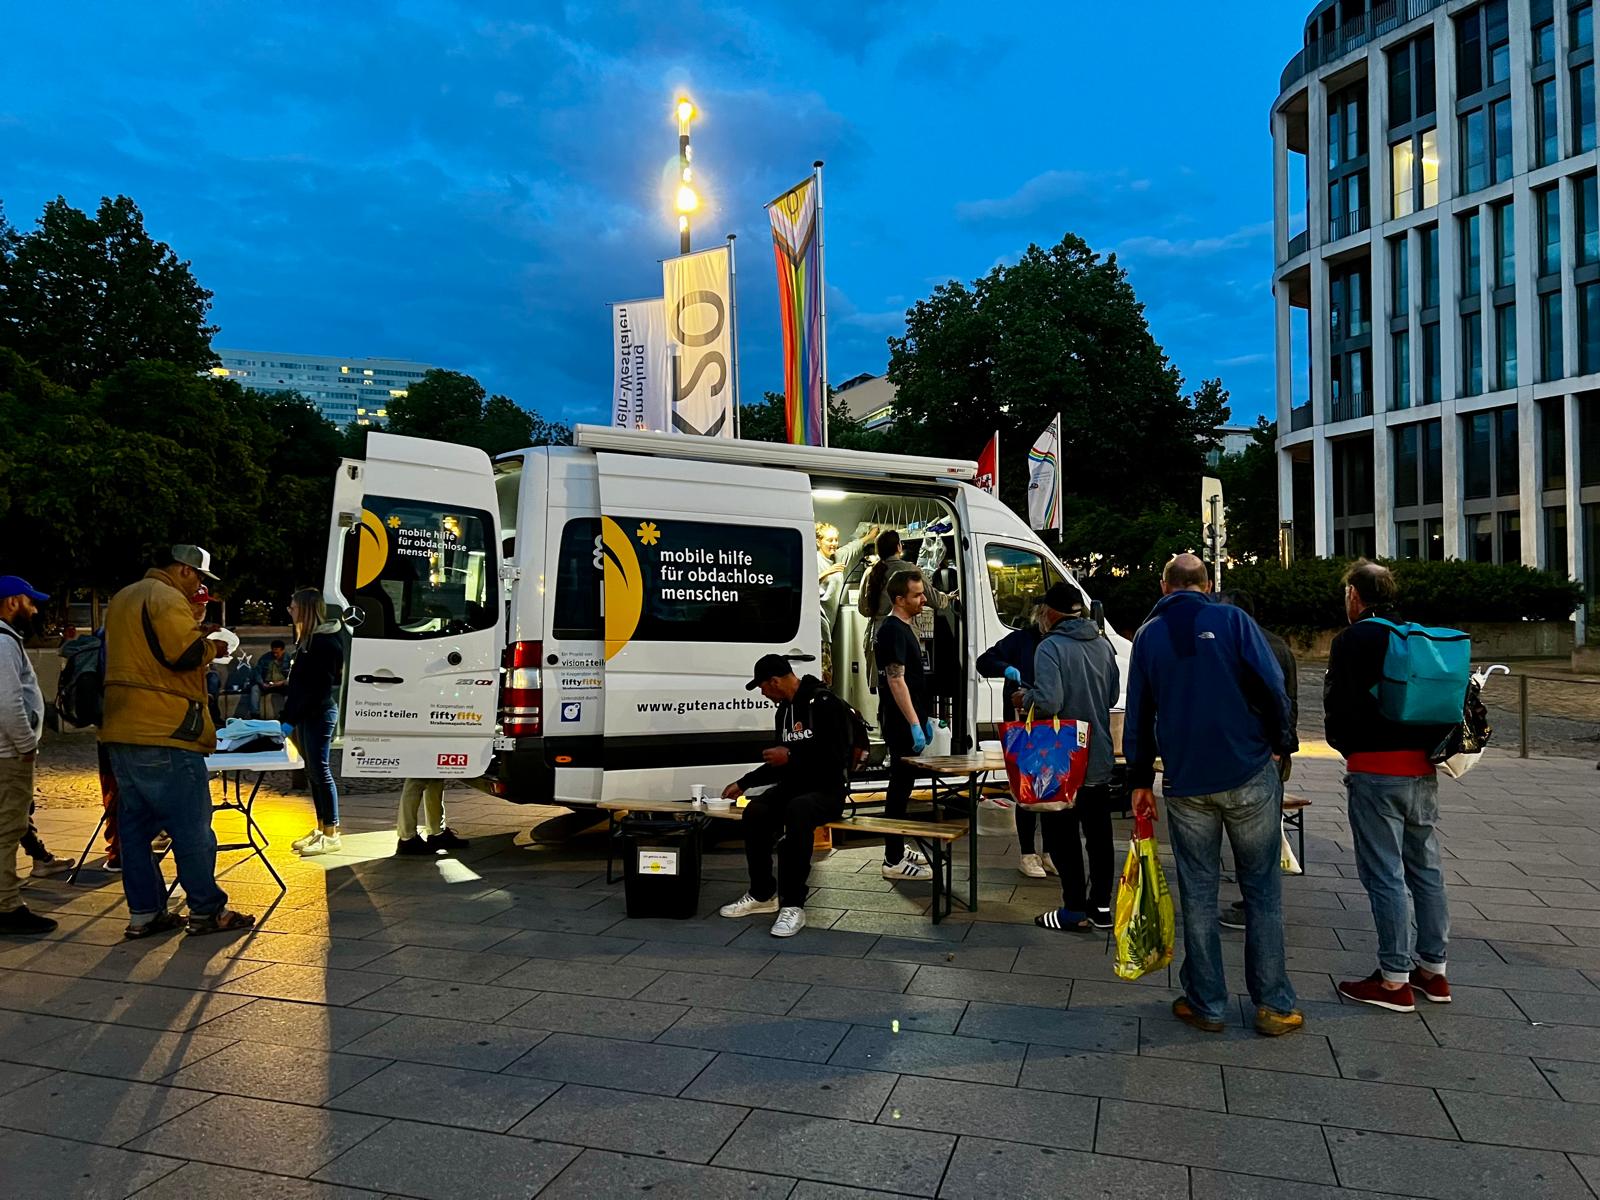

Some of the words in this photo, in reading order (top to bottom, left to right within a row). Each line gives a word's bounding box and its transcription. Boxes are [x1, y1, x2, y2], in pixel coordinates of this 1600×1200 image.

[399, 528, 431, 537] mobile
[434, 531, 455, 540] hilfe
[399, 536, 412, 545] für
[414, 538, 467, 551] obdachlose
[660, 548, 714, 564] mobile
[718, 549, 753, 566] hilfe
[660, 565, 683, 581] für
[687, 566, 774, 585] obdachlose
[661, 586, 739, 602] menschen
[430, 711, 483, 722] fiftyfifty
[356, 757, 400, 766] THEDENS
[439, 755, 466, 765] PCR
